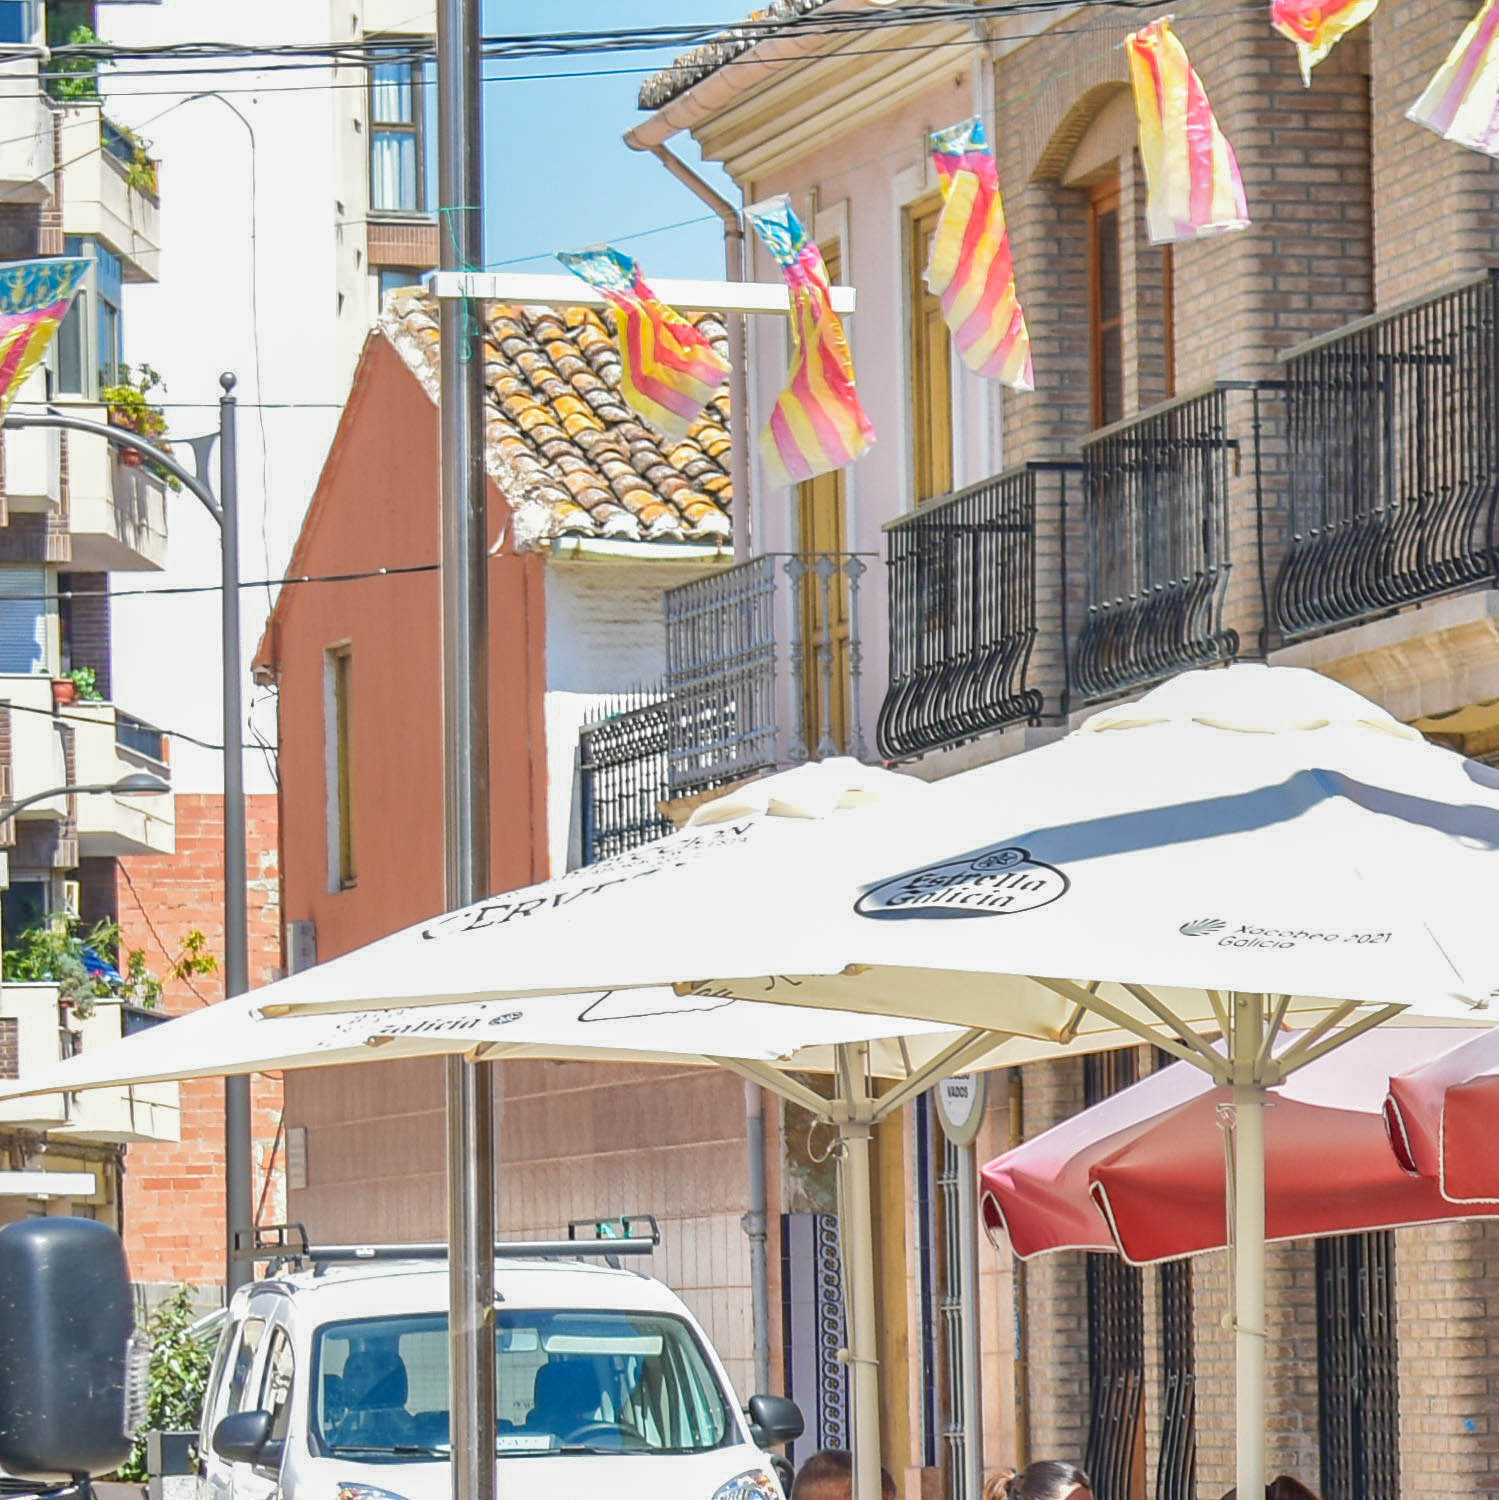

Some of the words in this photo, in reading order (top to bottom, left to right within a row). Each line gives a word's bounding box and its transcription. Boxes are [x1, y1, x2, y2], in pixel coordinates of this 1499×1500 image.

[901, 872, 1047, 892] Estrella
[885, 887, 1016, 908] Galicia
[1344, 932, 1392, 944] 2021
